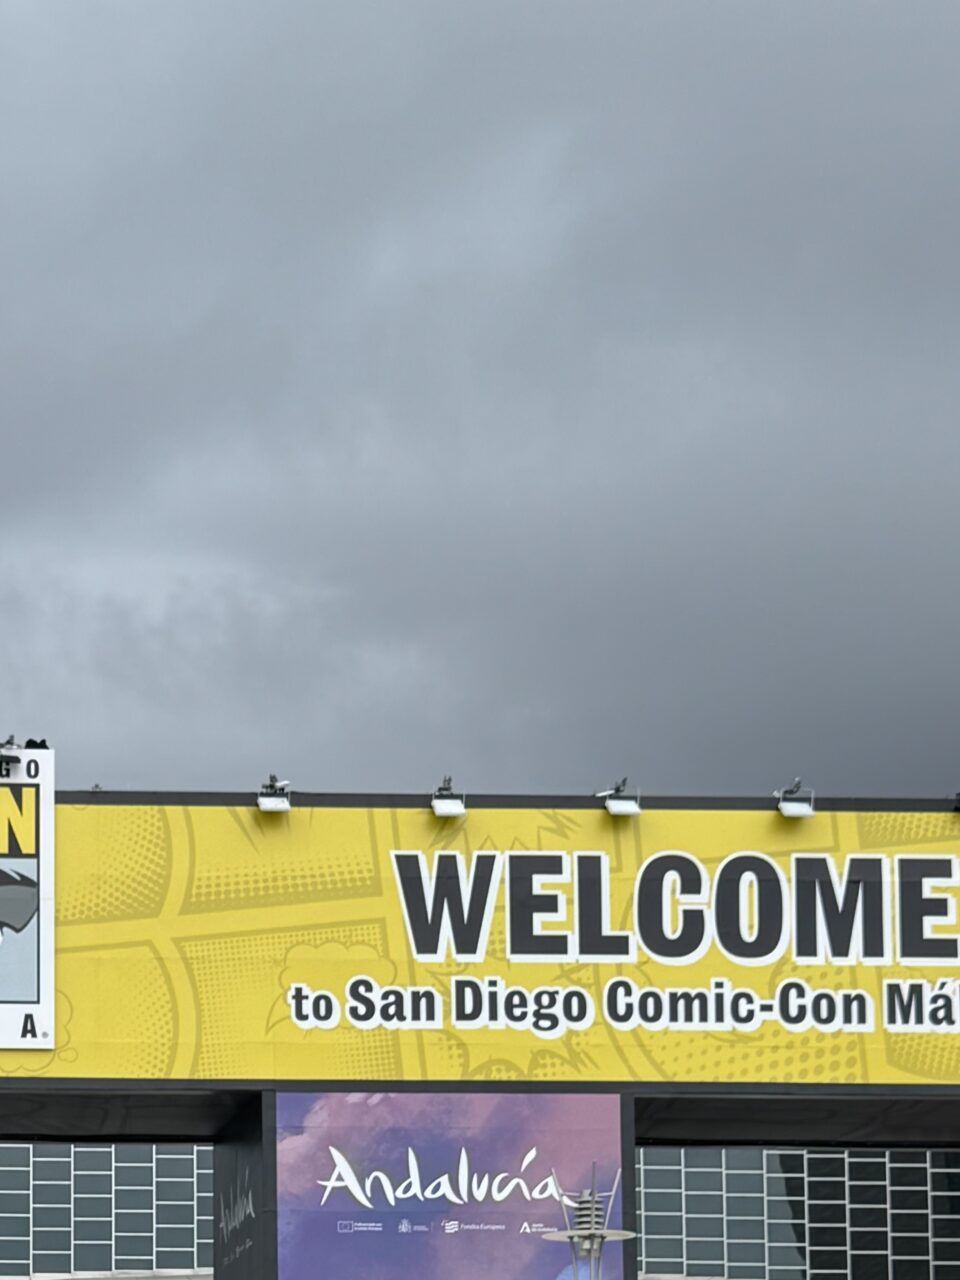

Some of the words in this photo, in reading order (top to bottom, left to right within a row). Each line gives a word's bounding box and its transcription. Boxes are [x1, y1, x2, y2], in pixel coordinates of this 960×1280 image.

[393, 854, 959, 959] WELCOME
[292, 986, 334, 1022] to
[348, 979, 436, 1022] San
[456, 981, 588, 1030] Diego
[607, 981, 867, 1025] Comic-Con
[887, 982, 960, 1025] Má
[317, 1146, 578, 1208] Andalucía
